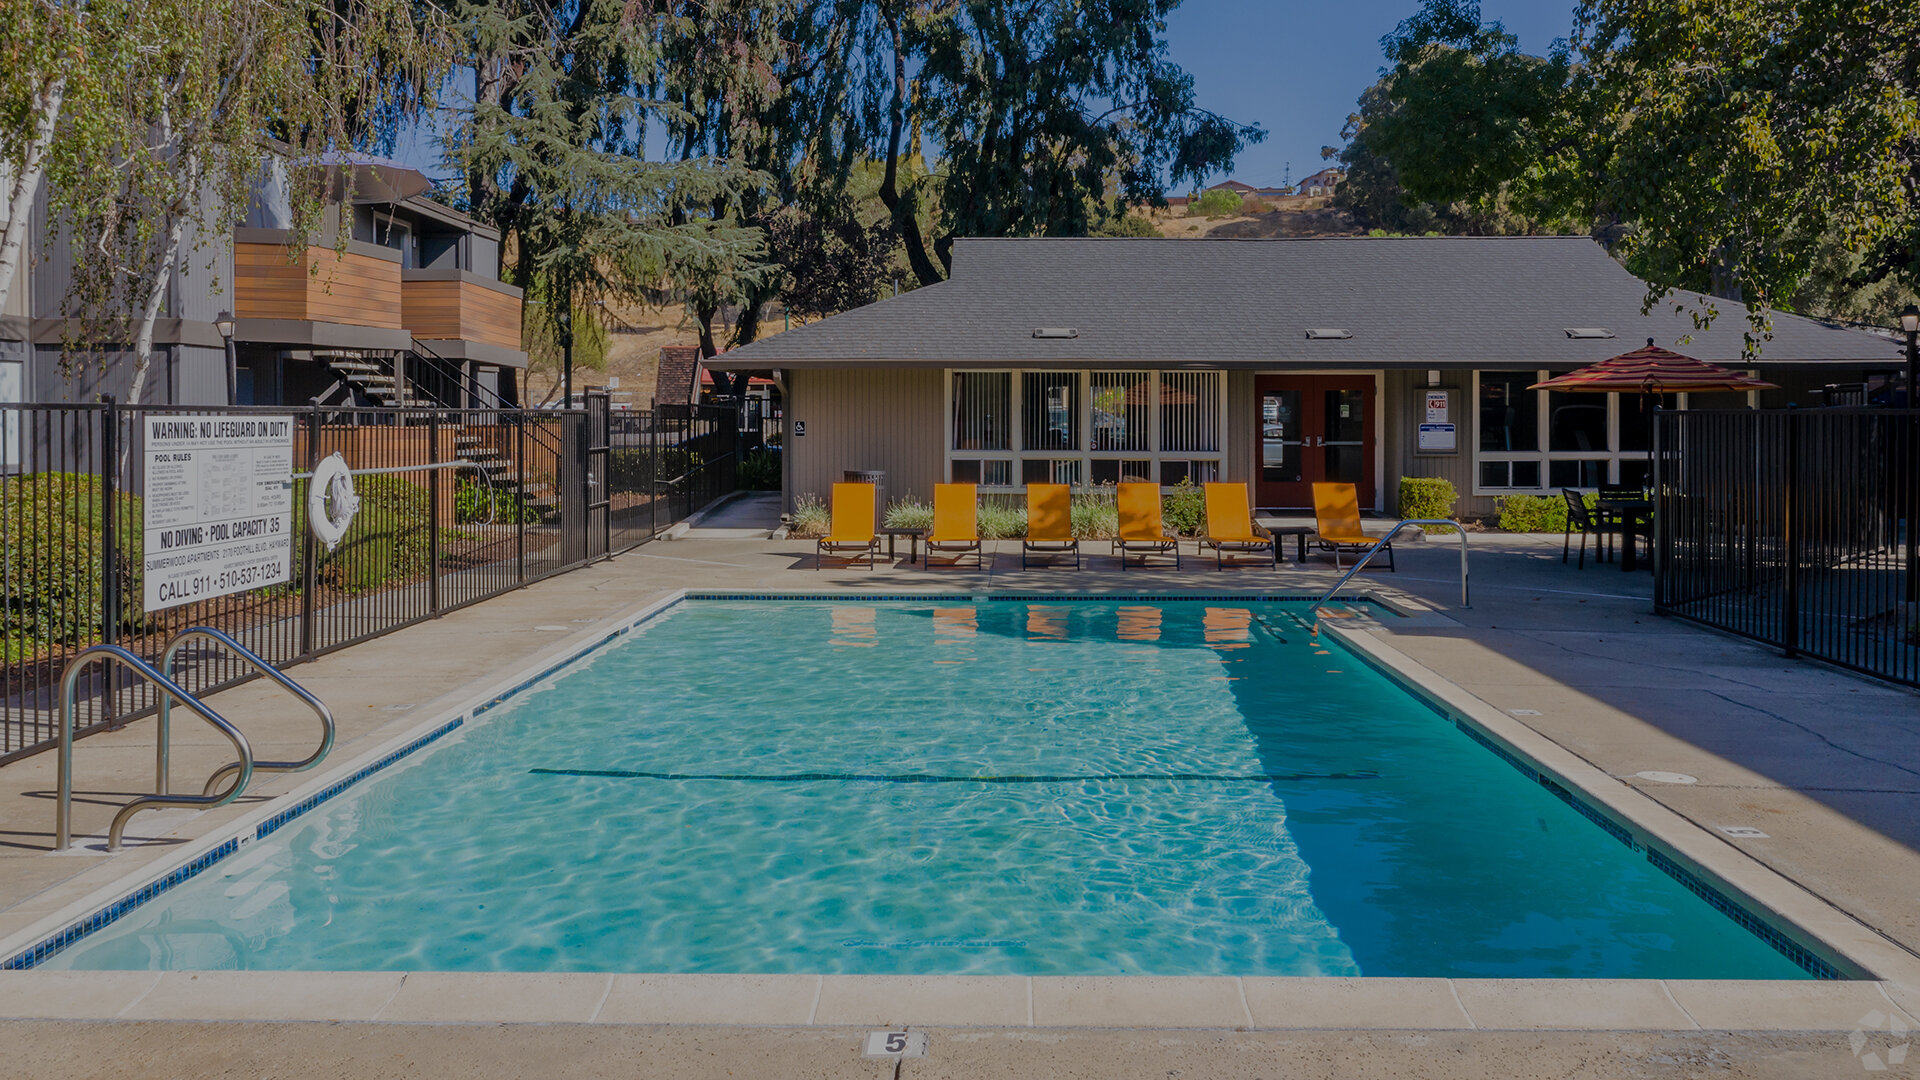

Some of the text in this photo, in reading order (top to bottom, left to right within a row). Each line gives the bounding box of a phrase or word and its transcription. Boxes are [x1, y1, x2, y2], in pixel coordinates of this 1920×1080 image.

[152, 421, 288, 439] WARNING: NO LIFEGUARD ON DUTY
[154, 453, 191, 463] POOL RULES
[160, 516, 280, 549] NO DIVING POOL CAPACITY 35
[146, 555, 186, 571] SUMMERWOOD
[187, 549, 219, 564] APARTMENTS
[233, 544, 254, 556] FOOTHILL
[269, 538, 289, 550] HAYWARD
[159, 578, 190, 602] CALL
[193, 574, 210, 595] 911
[219, 561, 281, 590] 510-537-1234
[885, 1033, 906, 1053] 5
